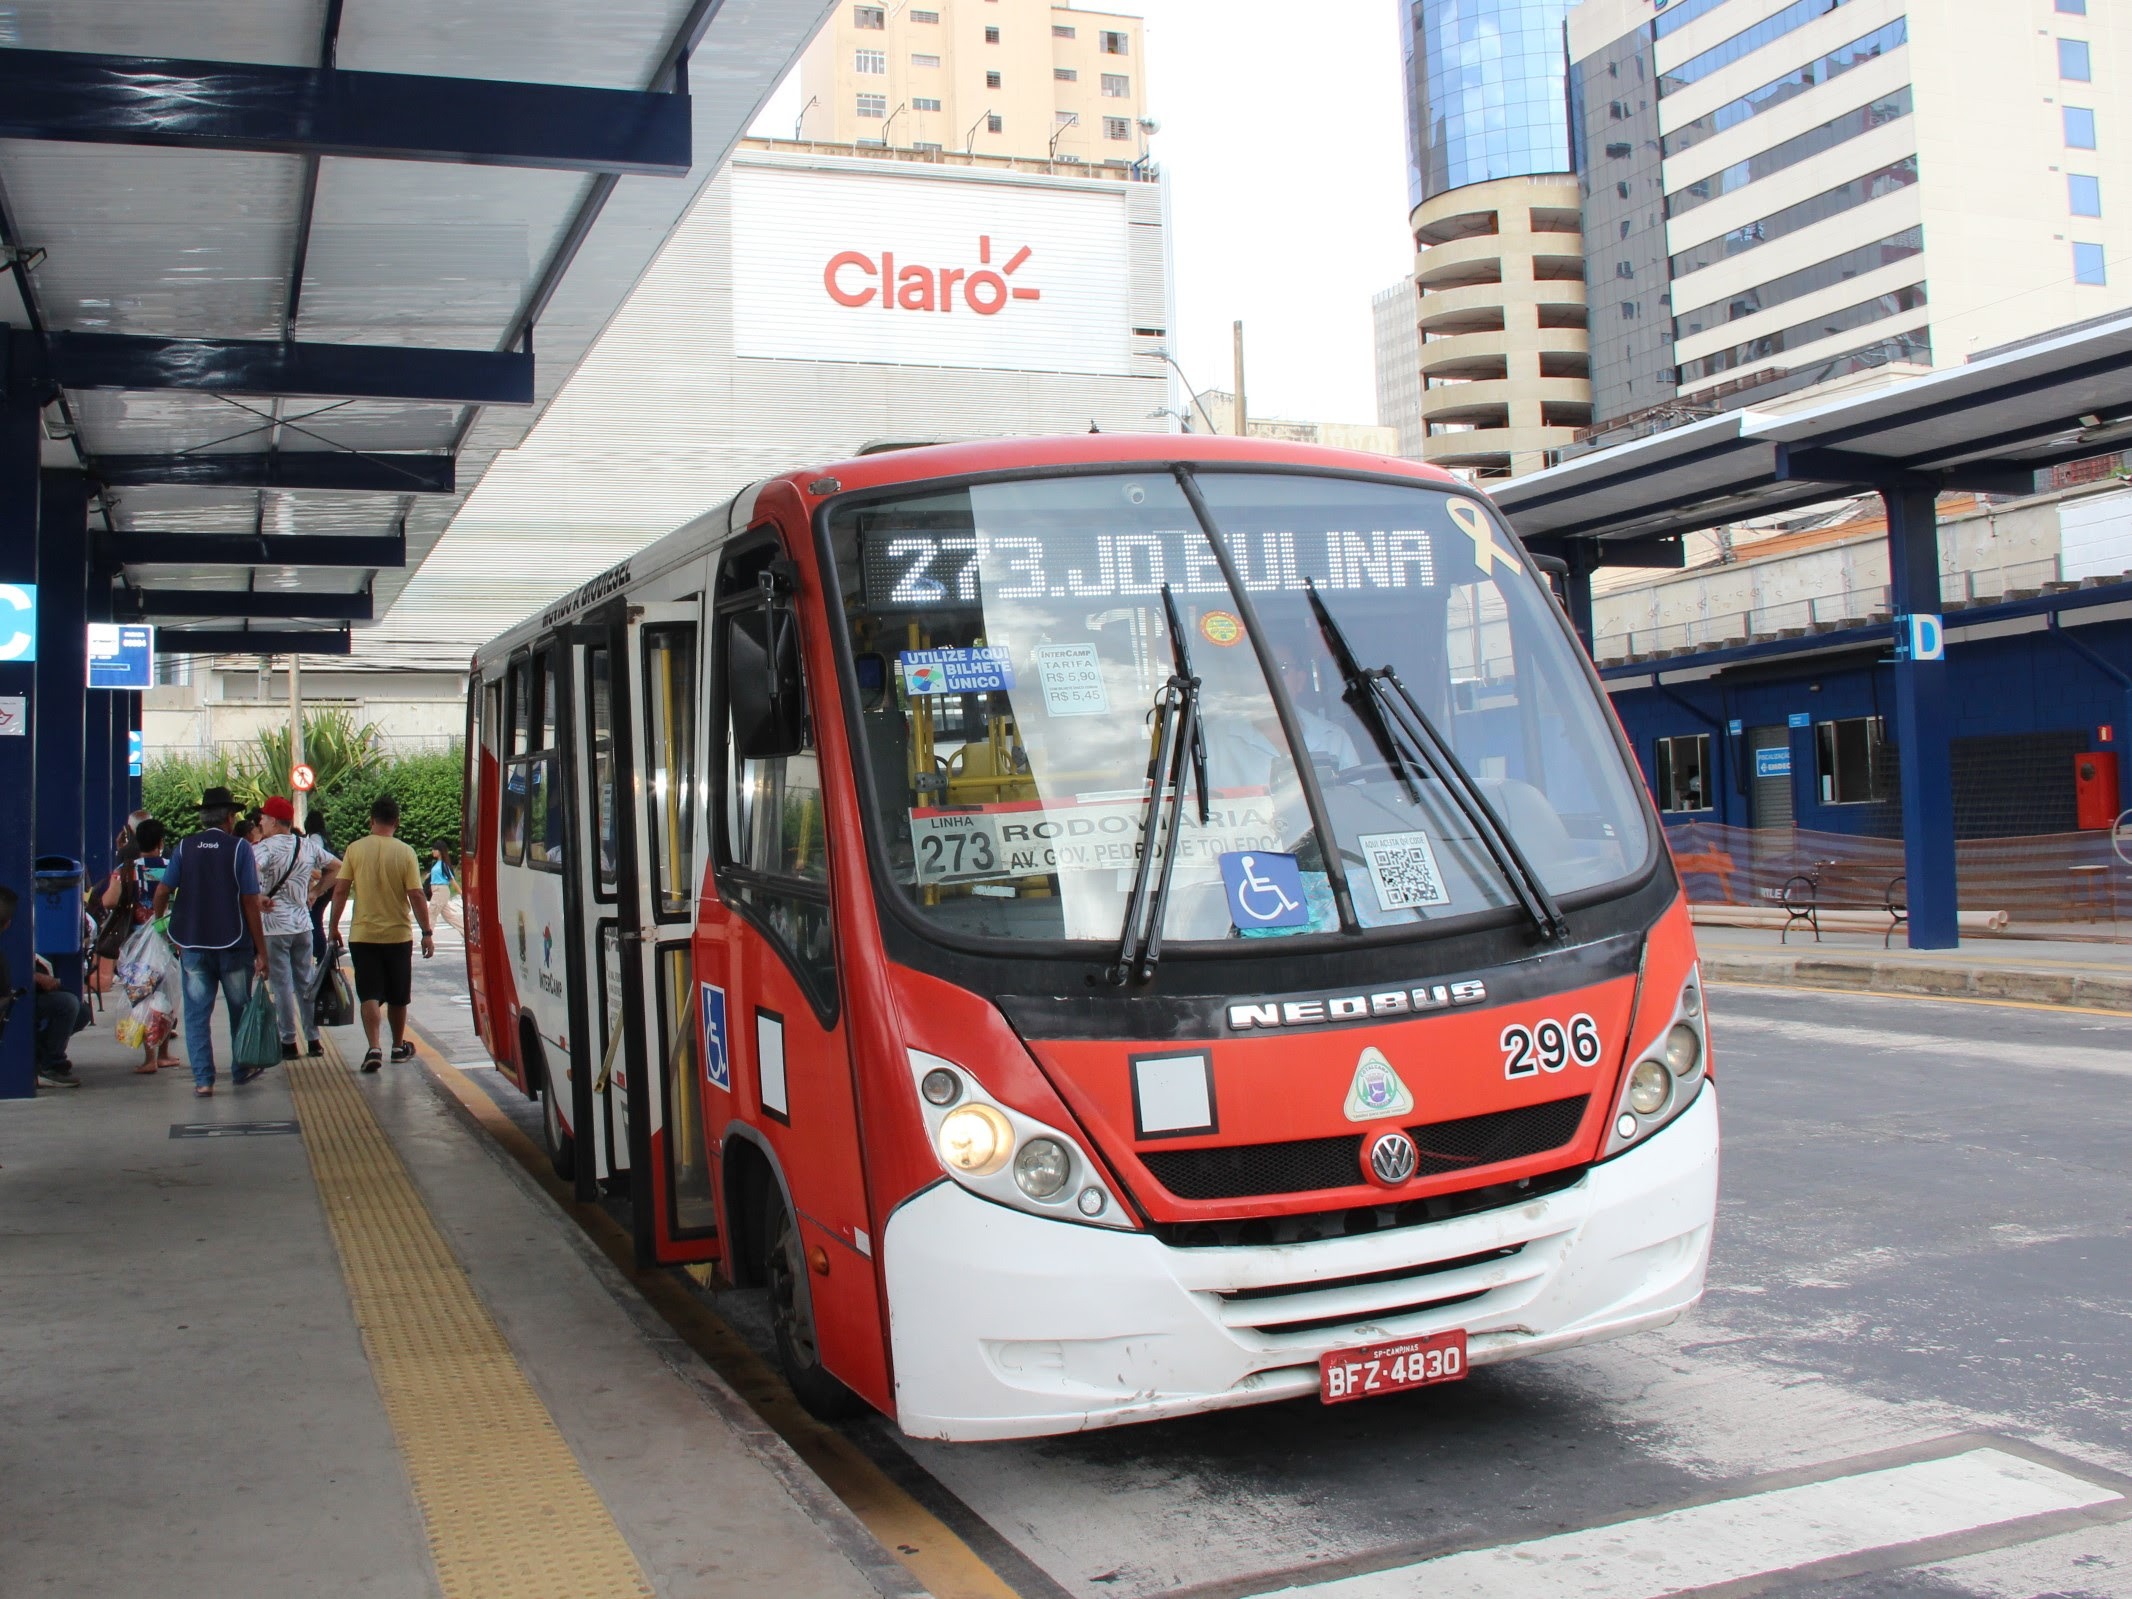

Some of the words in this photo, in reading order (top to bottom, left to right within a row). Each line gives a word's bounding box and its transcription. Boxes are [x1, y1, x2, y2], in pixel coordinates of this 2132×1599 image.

[823, 250, 1008, 315] Claro
[1912, 613, 1943, 660] D
[907, 650, 967, 665] UTILIZE
[971, 648, 1010, 662] AQUI
[1043, 660, 1093, 669] TARIFA
[946, 659, 1012, 675] BILHETE
[948, 674, 1000, 690] ÚNICO
[1046, 672, 1064, 683] R$
[1068, 671, 1096, 684] 5,90
[1050, 691, 1069, 702] R$
[1072, 689, 1100, 702] 5,45
[931, 816, 974, 829] LINHA
[197, 841, 219, 849] José
[921, 831, 995, 873] 273
[1011, 850, 1039, 870] AV.
[1044, 845, 1090, 866] GOV.
[1230, 980, 1485, 1028] NEOBUS
[1500, 1013, 1602, 1081] 296
